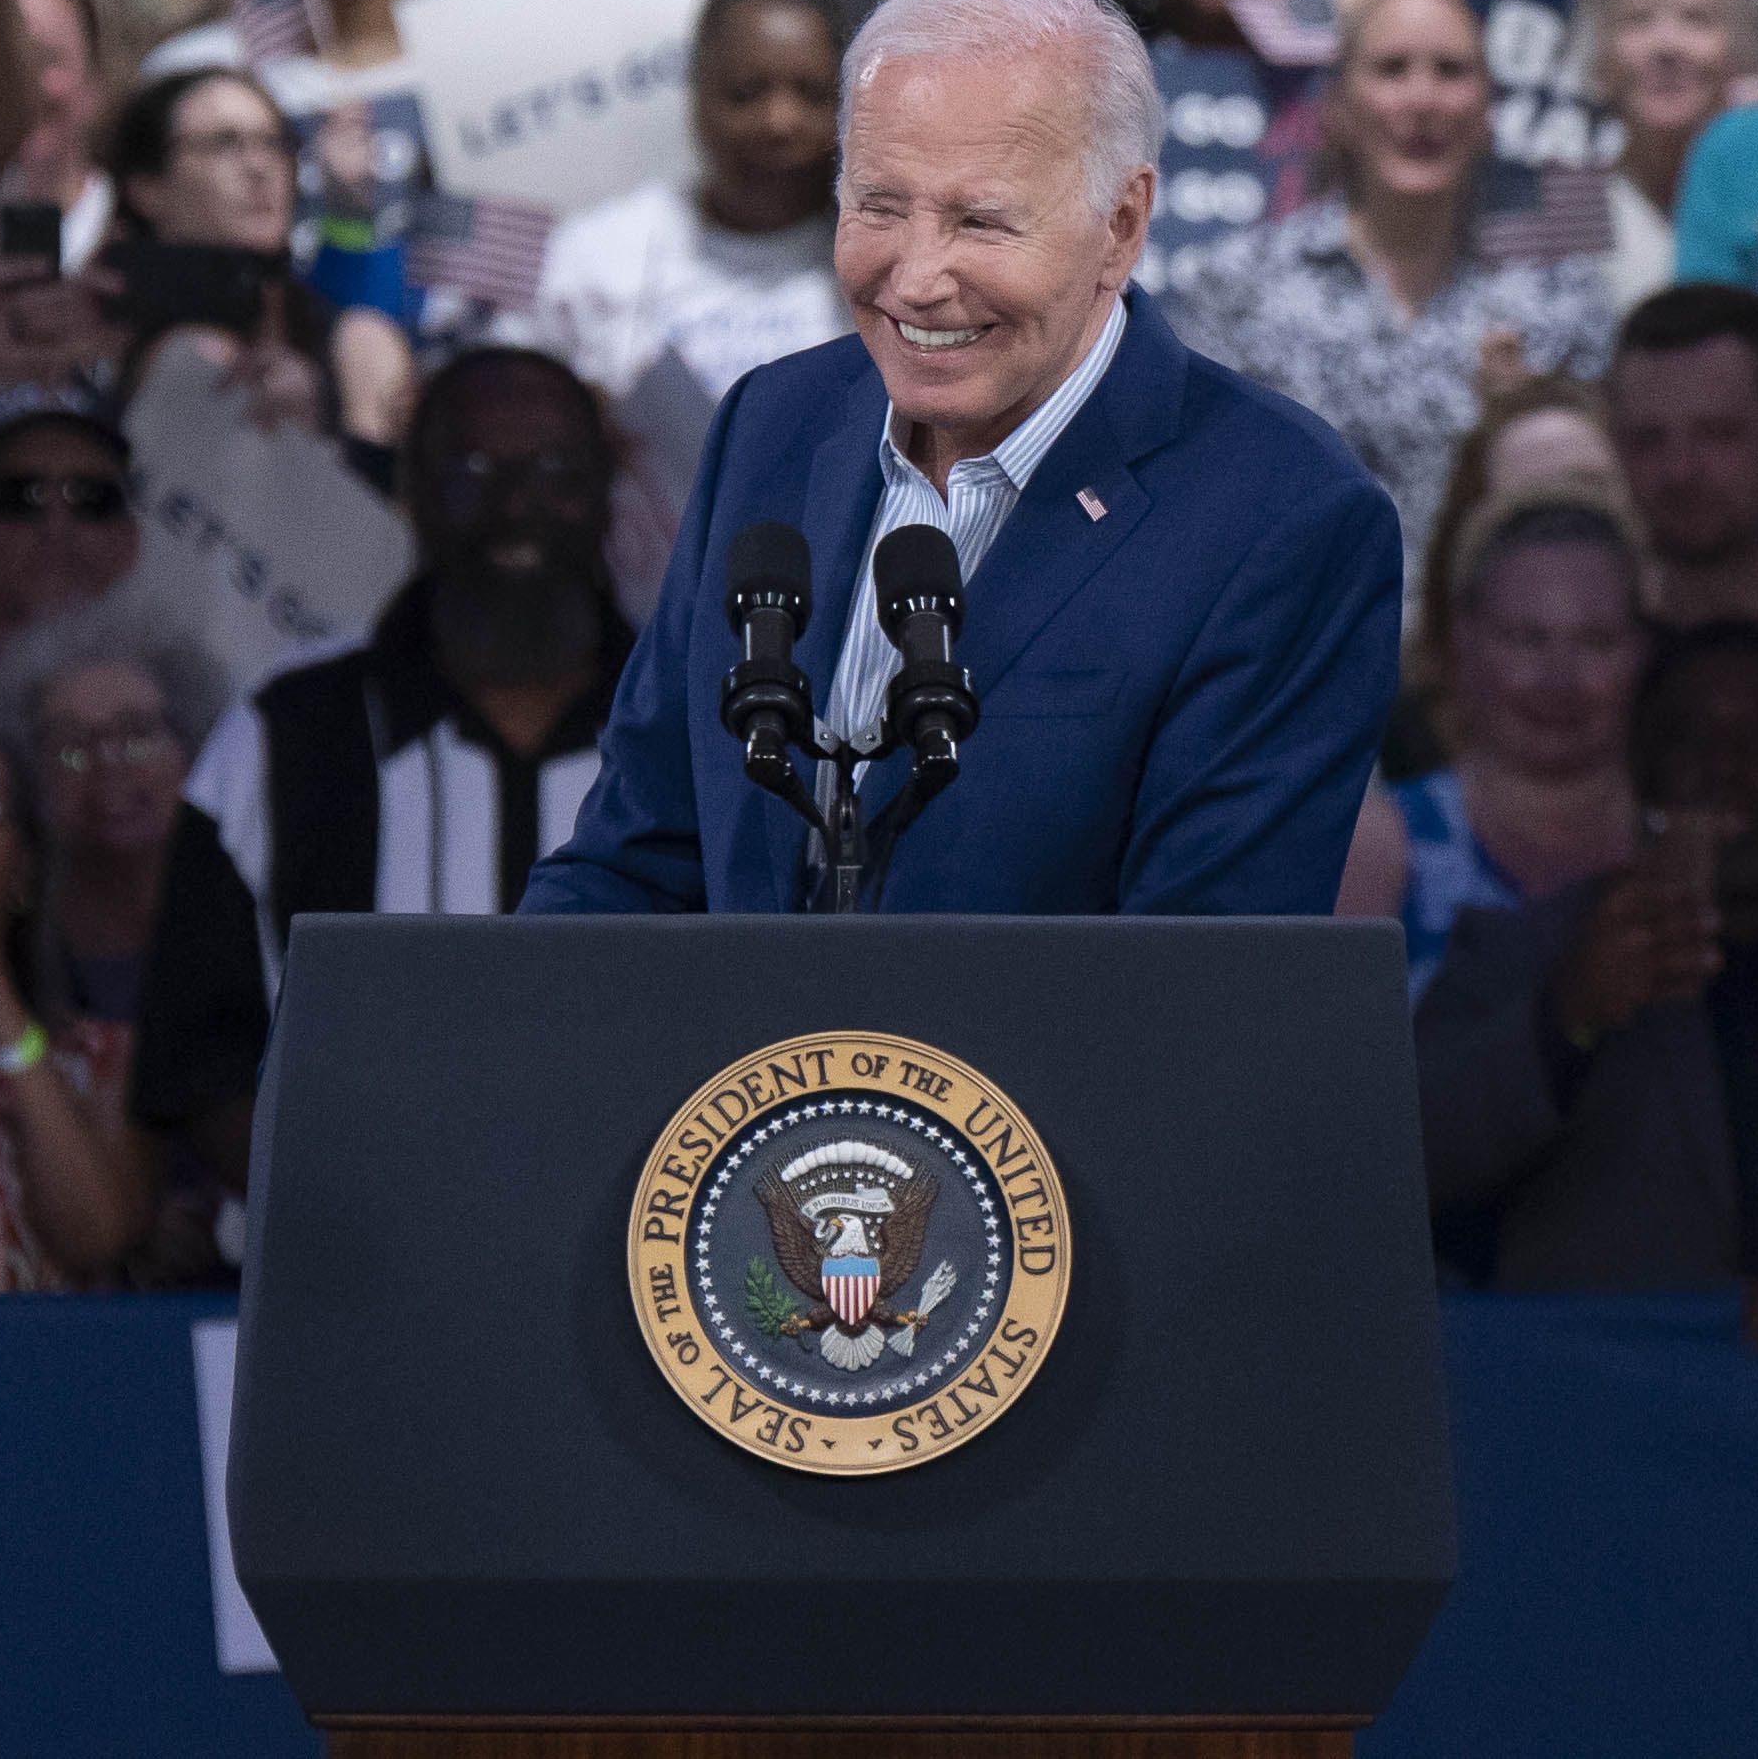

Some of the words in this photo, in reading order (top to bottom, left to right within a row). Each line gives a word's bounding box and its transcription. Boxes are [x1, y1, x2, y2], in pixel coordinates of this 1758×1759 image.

[850, 1051, 892, 1081] OF
[899, 1058, 954, 1104] THE
[643, 1048, 836, 1247] PRESIDENT
[812, 1196, 860, 1211] PLURIBUS
[963, 1098, 1056, 1276] UNITED
[648, 1262, 682, 1326] THE
[665, 1329, 702, 1368] OF
[701, 1363, 813, 1454] SEAL
[891, 1317, 1039, 1454] STATES
